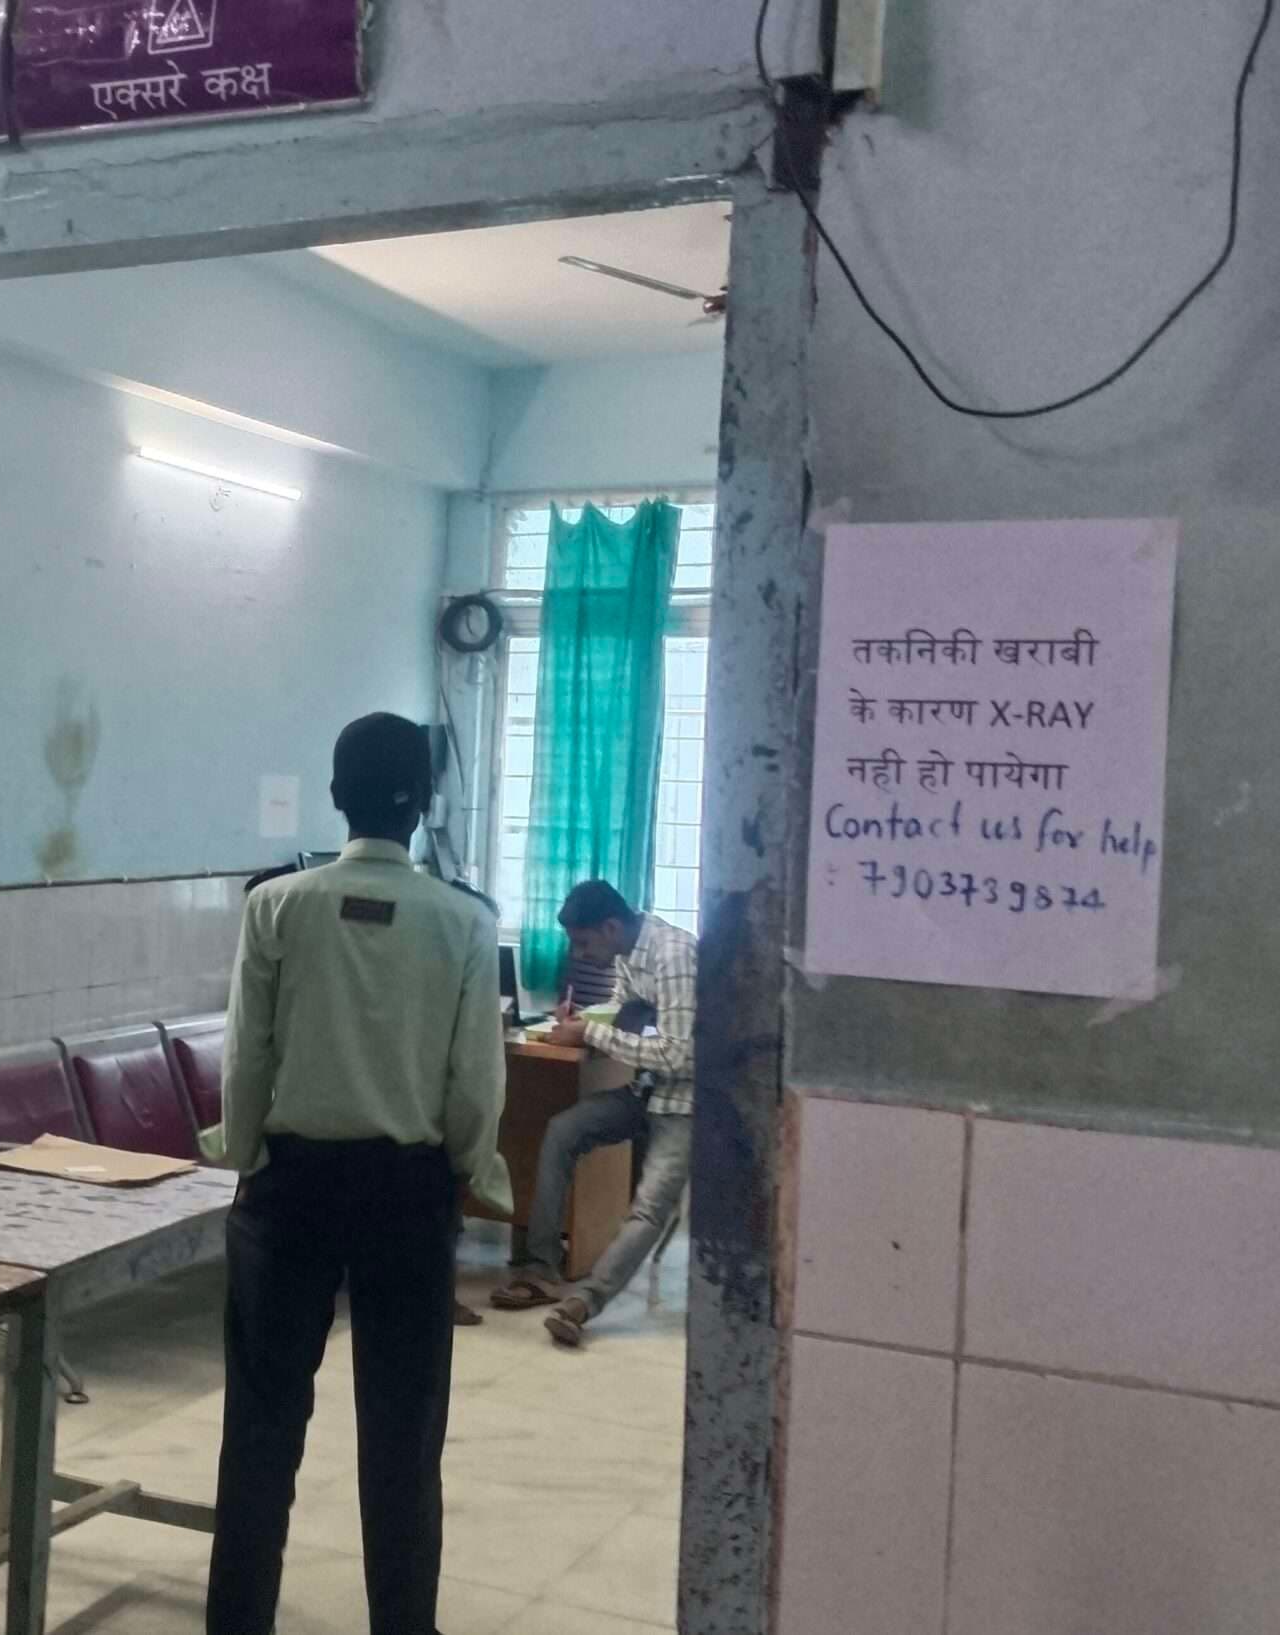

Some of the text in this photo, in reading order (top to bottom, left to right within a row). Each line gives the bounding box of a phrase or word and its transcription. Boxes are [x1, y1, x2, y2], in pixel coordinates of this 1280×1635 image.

[90, 60, 273, 119] एक्सरे कक्ष
[852, 628, 1101, 667] तकनिकी खराबी
[849, 688, 1095, 729] के कारण X-RAY
[847, 748, 1070, 794] नही हो पायेगा
[824, 800, 1157, 874] Contact us for help
